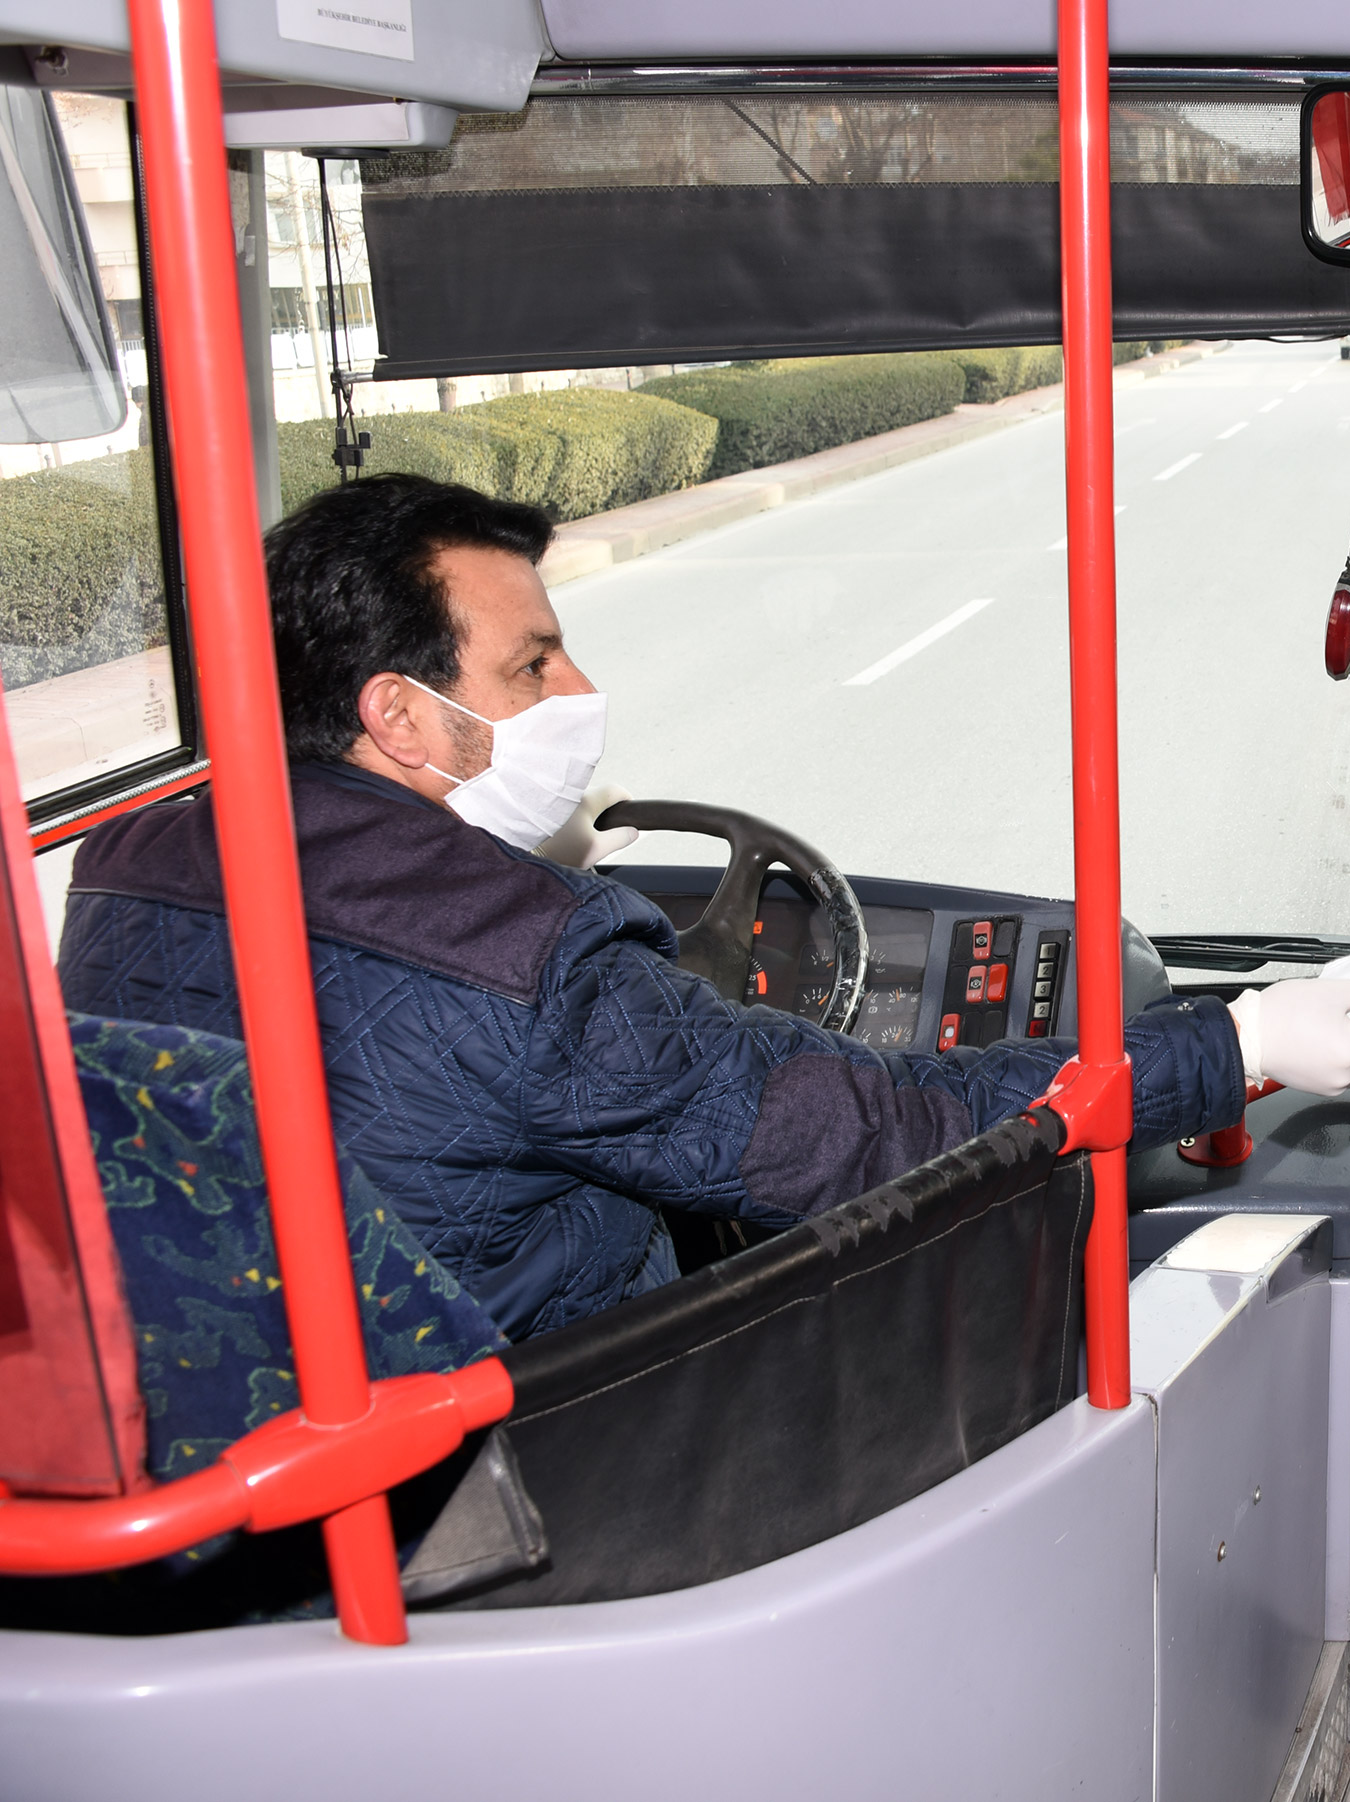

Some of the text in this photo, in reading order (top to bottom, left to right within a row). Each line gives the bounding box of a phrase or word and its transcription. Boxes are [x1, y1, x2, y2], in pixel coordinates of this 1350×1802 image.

[1042, 966, 1049, 975] 2
[1040, 985, 1047, 994] 3
[1039, 1006, 1046, 1015] 2
